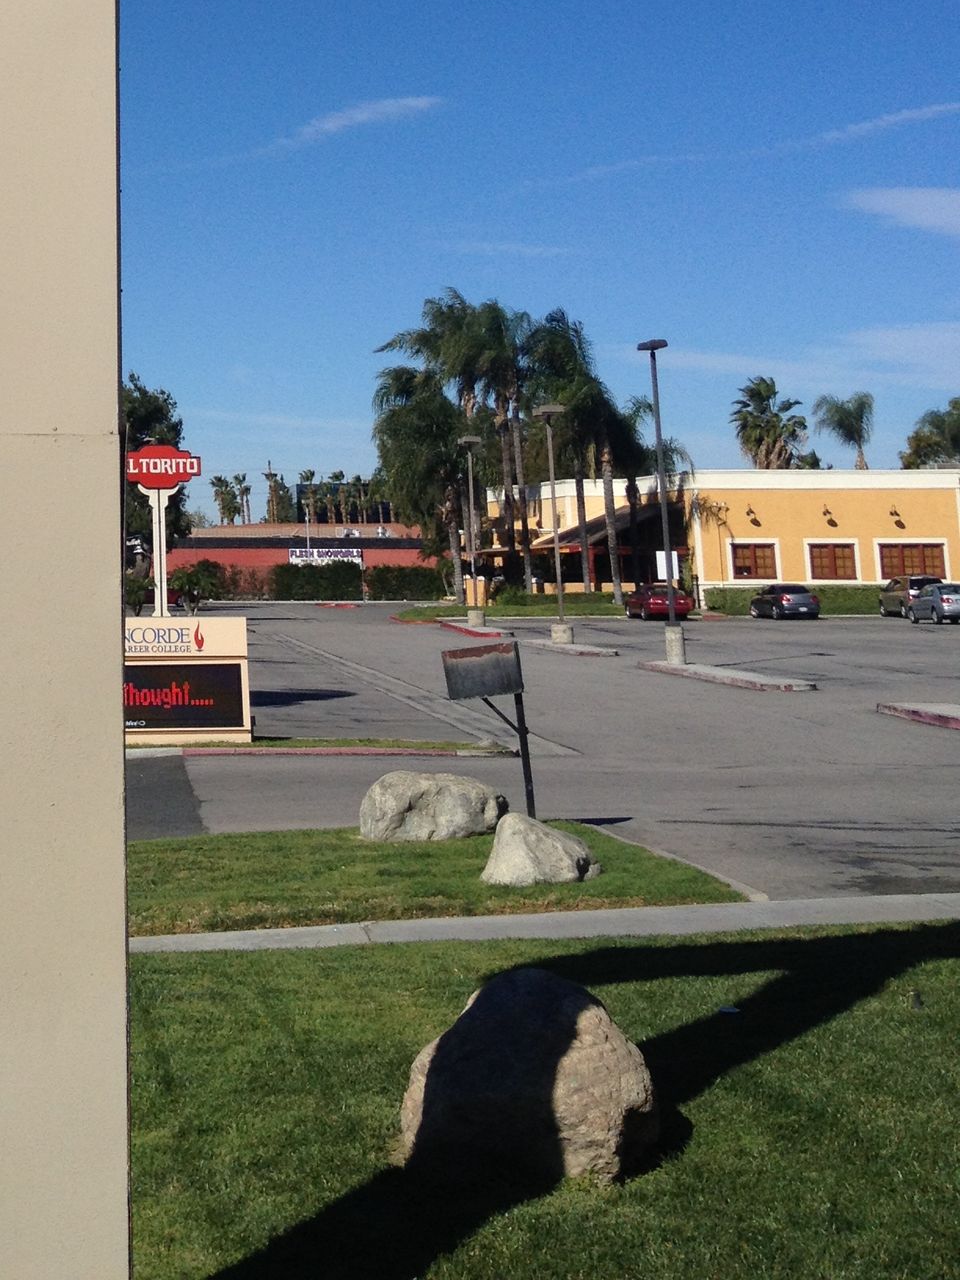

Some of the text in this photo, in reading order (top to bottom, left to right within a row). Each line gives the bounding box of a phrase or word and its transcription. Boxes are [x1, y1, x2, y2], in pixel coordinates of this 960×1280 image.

[126, 458, 198, 474] L TORITO
[290, 549, 314, 558] FLESH
[151, 645, 192, 653] COLLEGE
